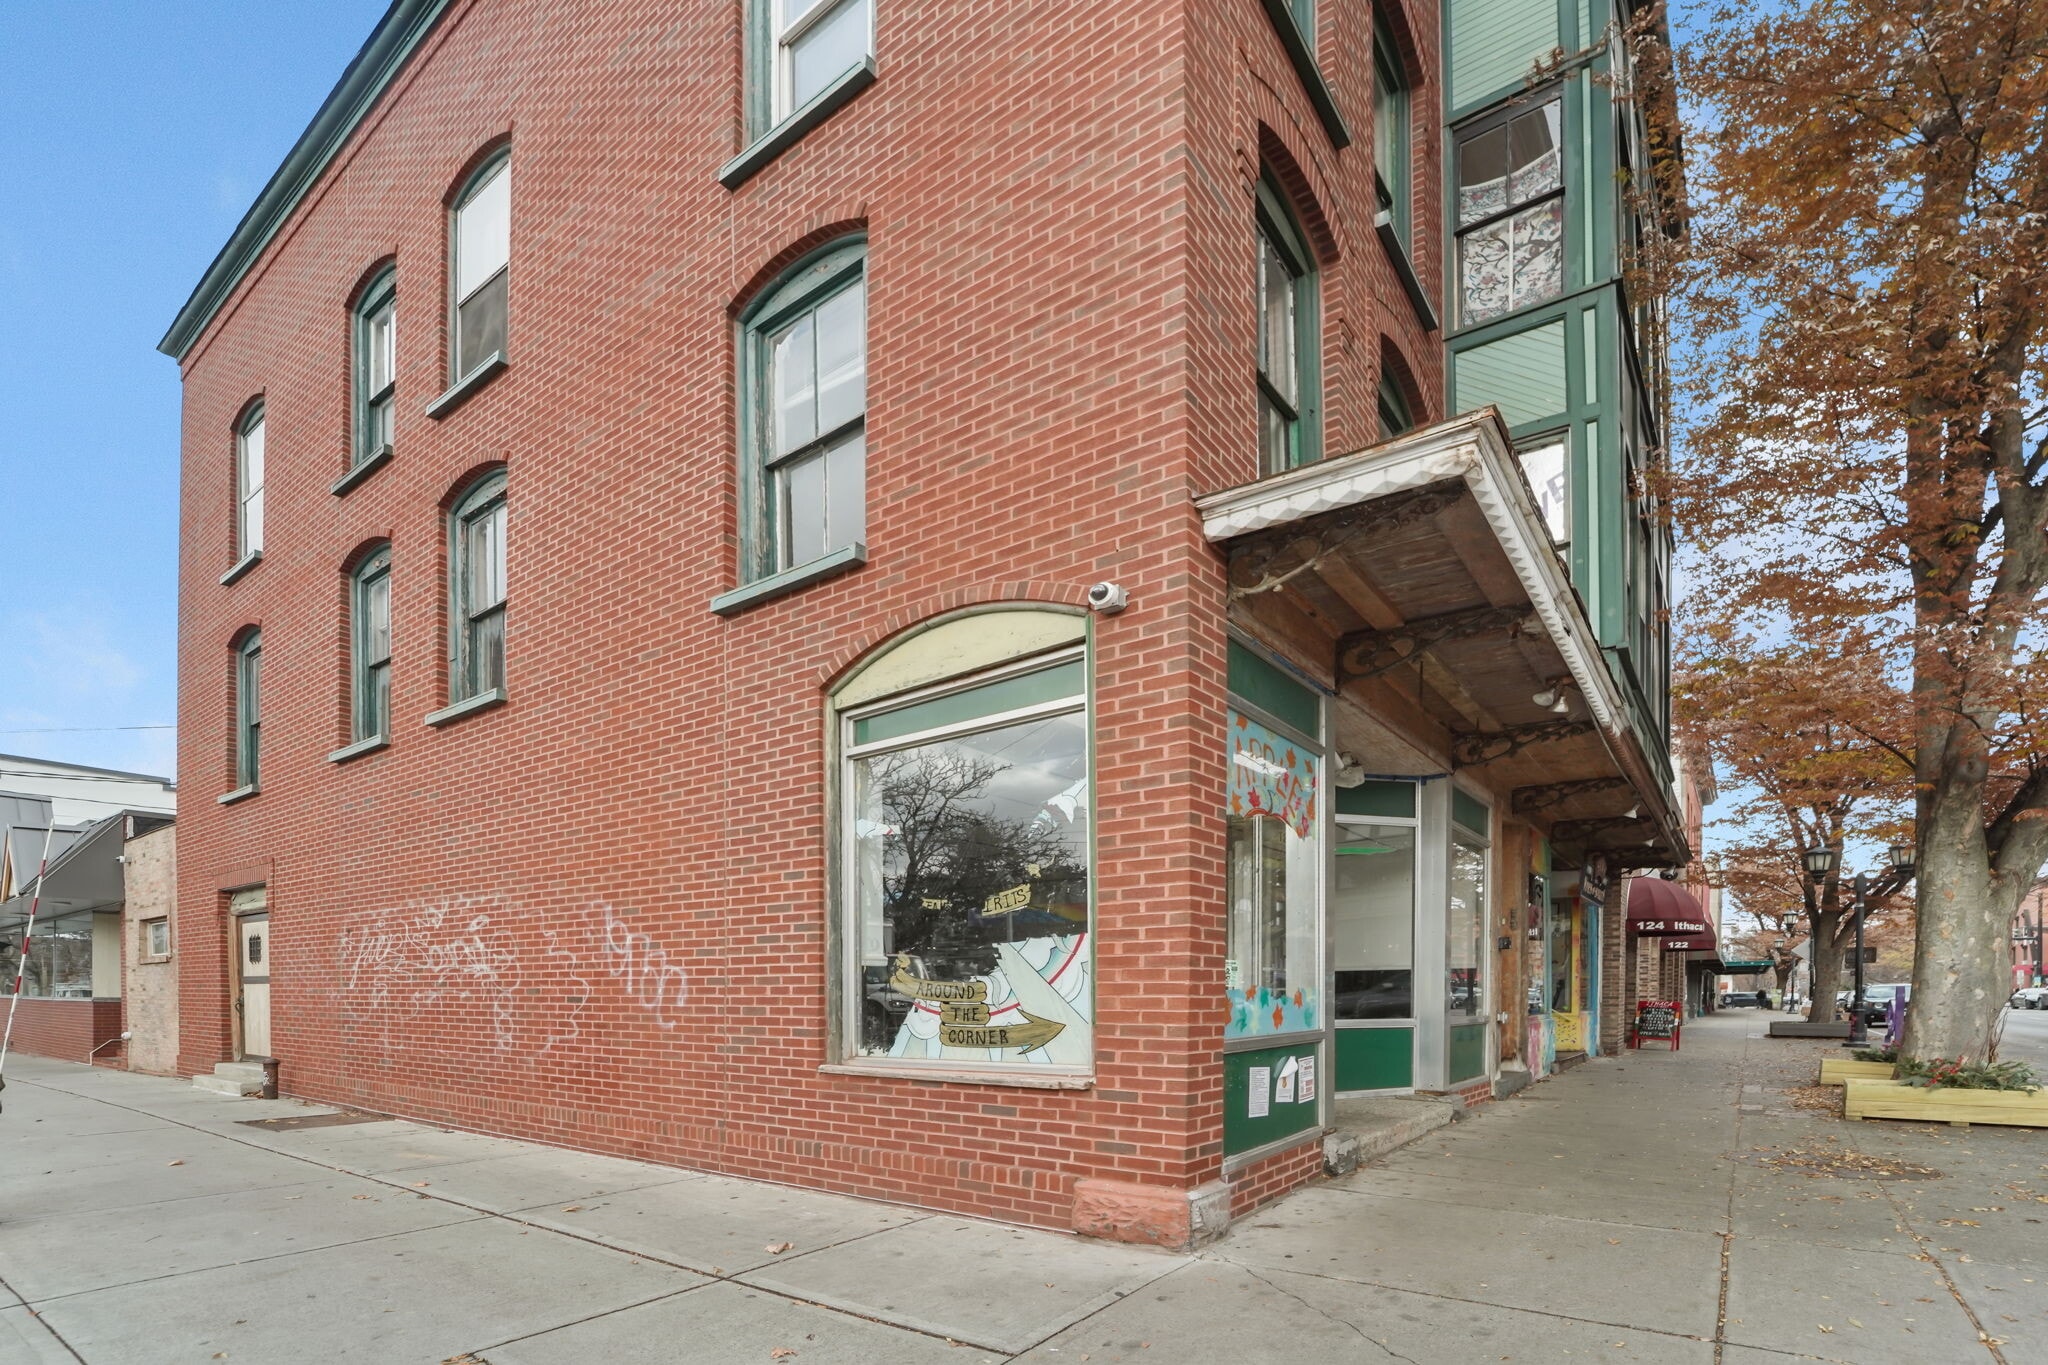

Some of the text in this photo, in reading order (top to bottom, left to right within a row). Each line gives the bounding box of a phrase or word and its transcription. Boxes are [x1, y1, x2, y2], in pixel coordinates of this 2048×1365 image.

[1636, 921, 1665, 930] 124
[1667, 941, 1689, 949] 122
[916, 982, 975, 999] AROUND
[950, 1007, 980, 1022] THE
[948, 1029, 1009, 1045] CORNER
